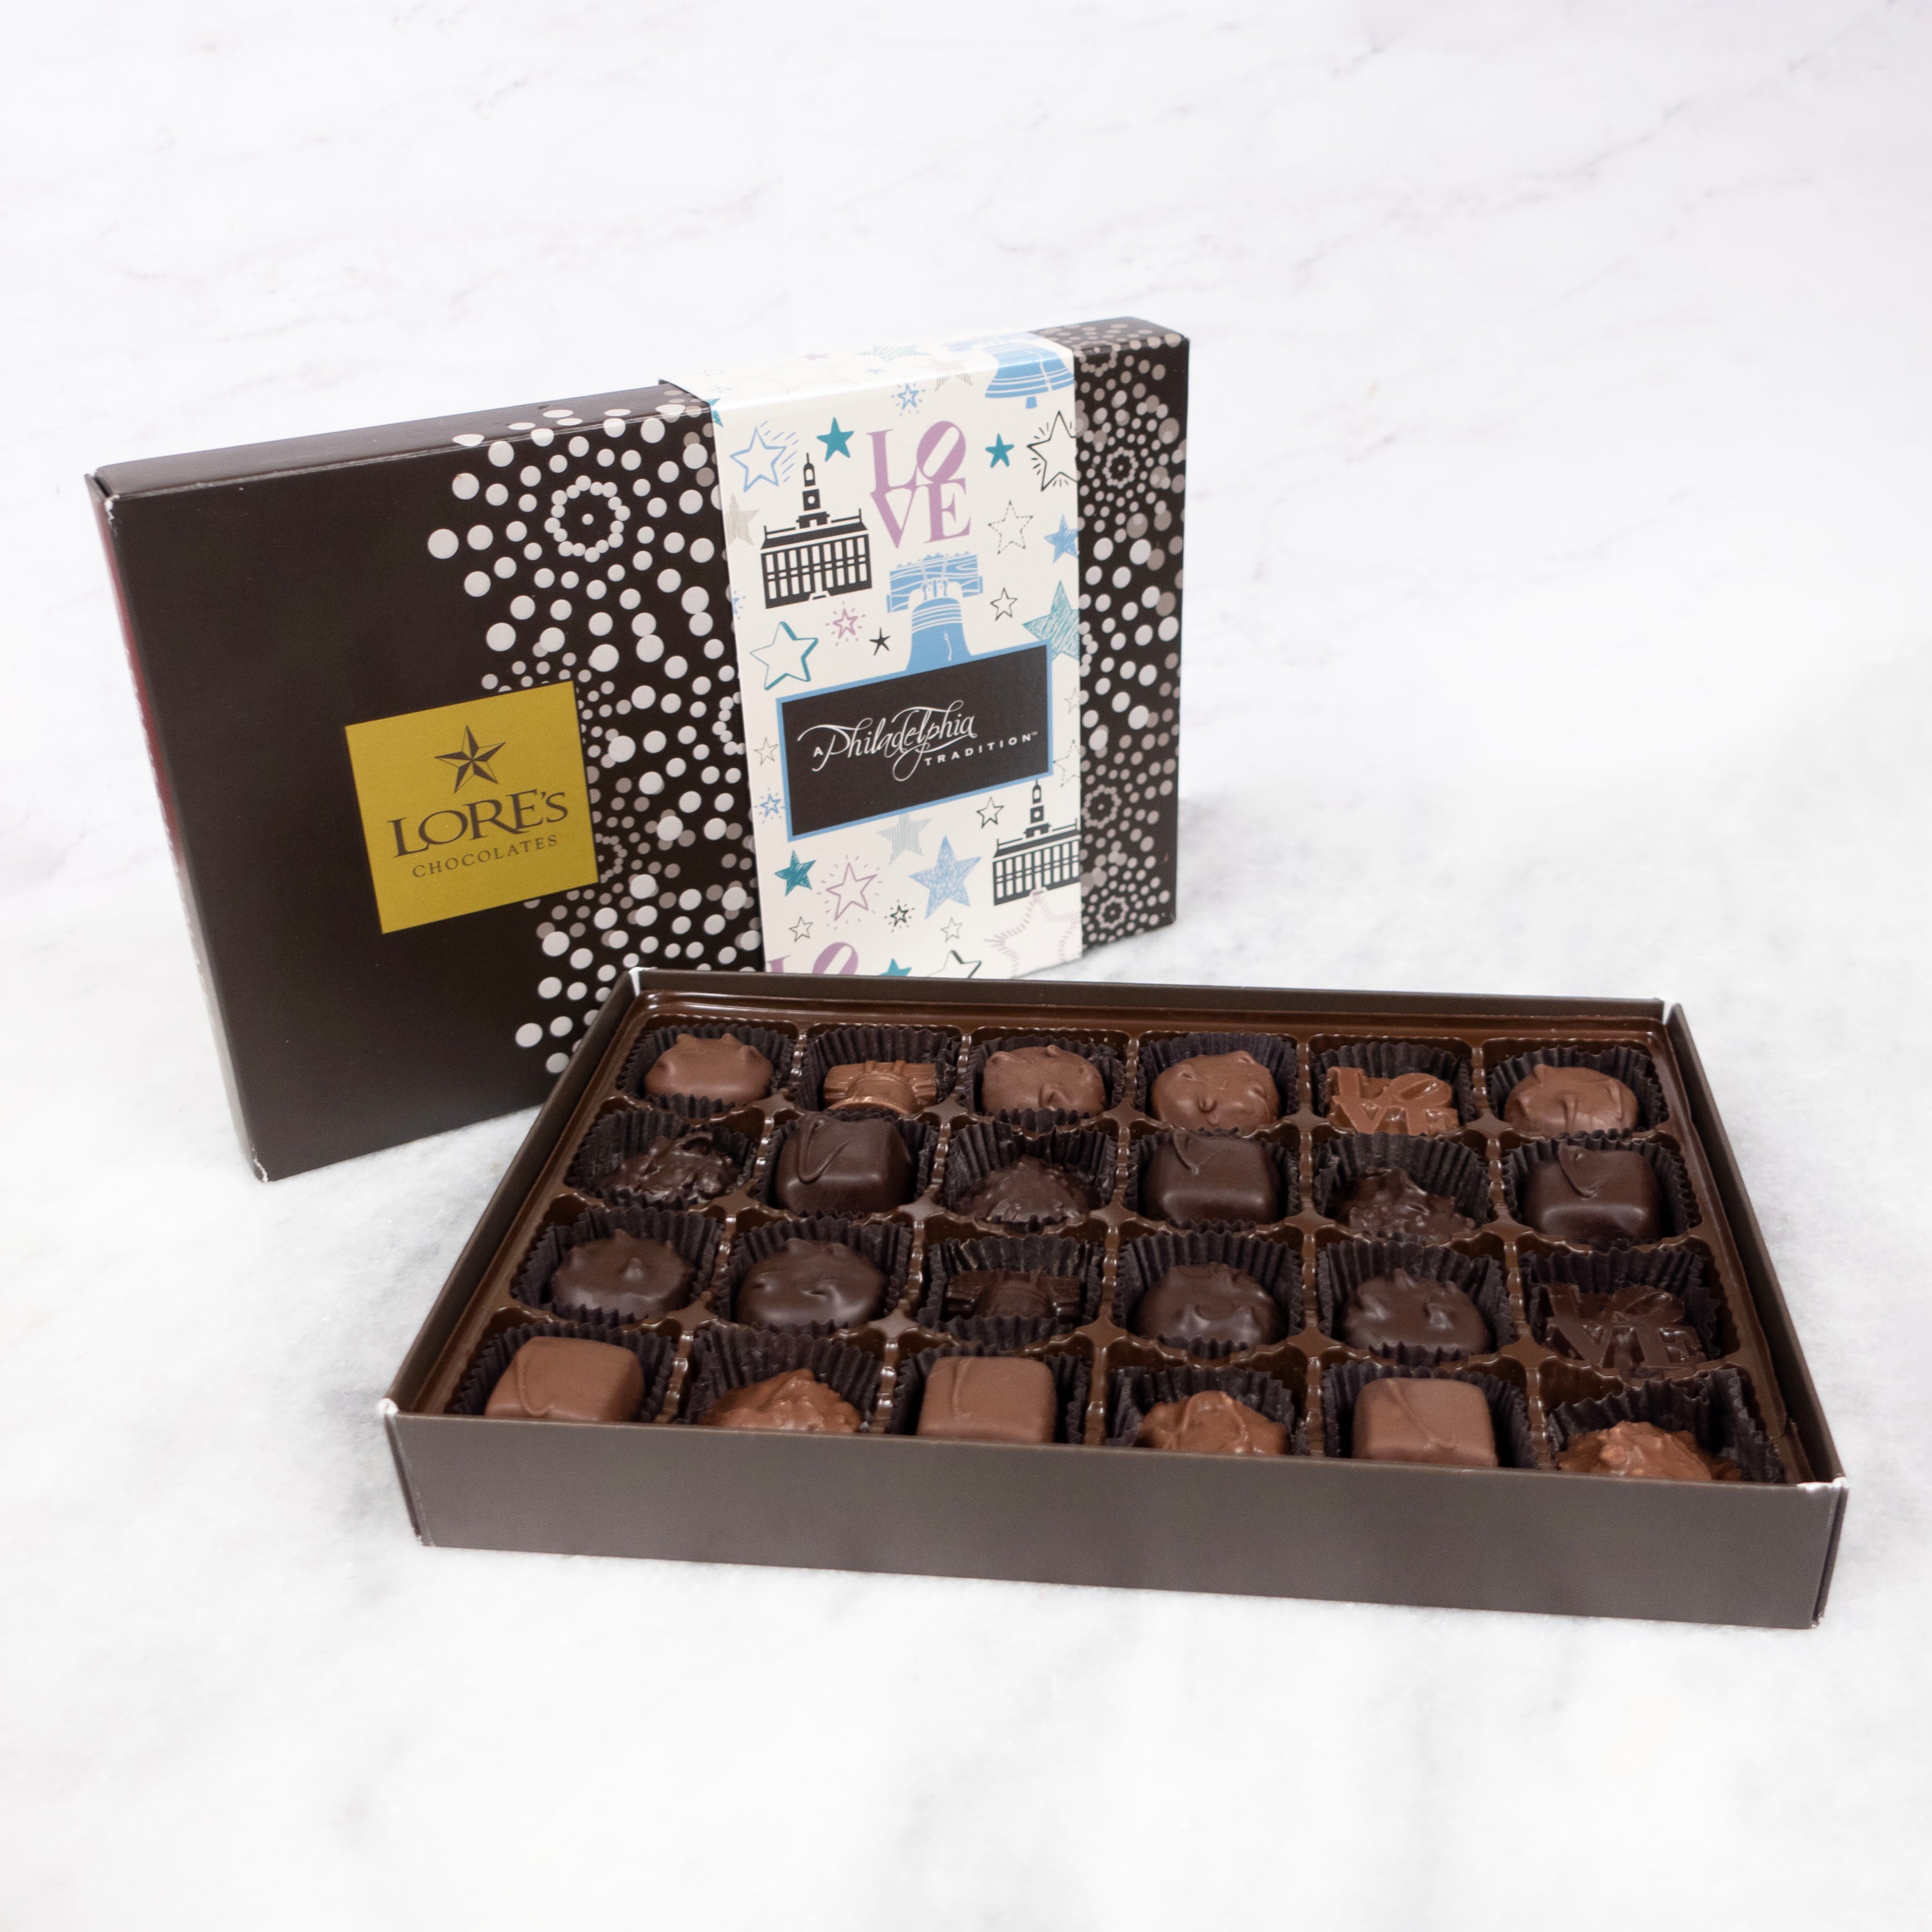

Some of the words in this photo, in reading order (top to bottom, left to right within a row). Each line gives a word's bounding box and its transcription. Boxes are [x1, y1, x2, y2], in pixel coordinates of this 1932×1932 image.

[797, 700, 977, 782] Philadelphia
[813, 746, 824, 757] A
[387, 788, 568, 858] LORE'S
[412, 835, 557, 878] CHOCOLATES
